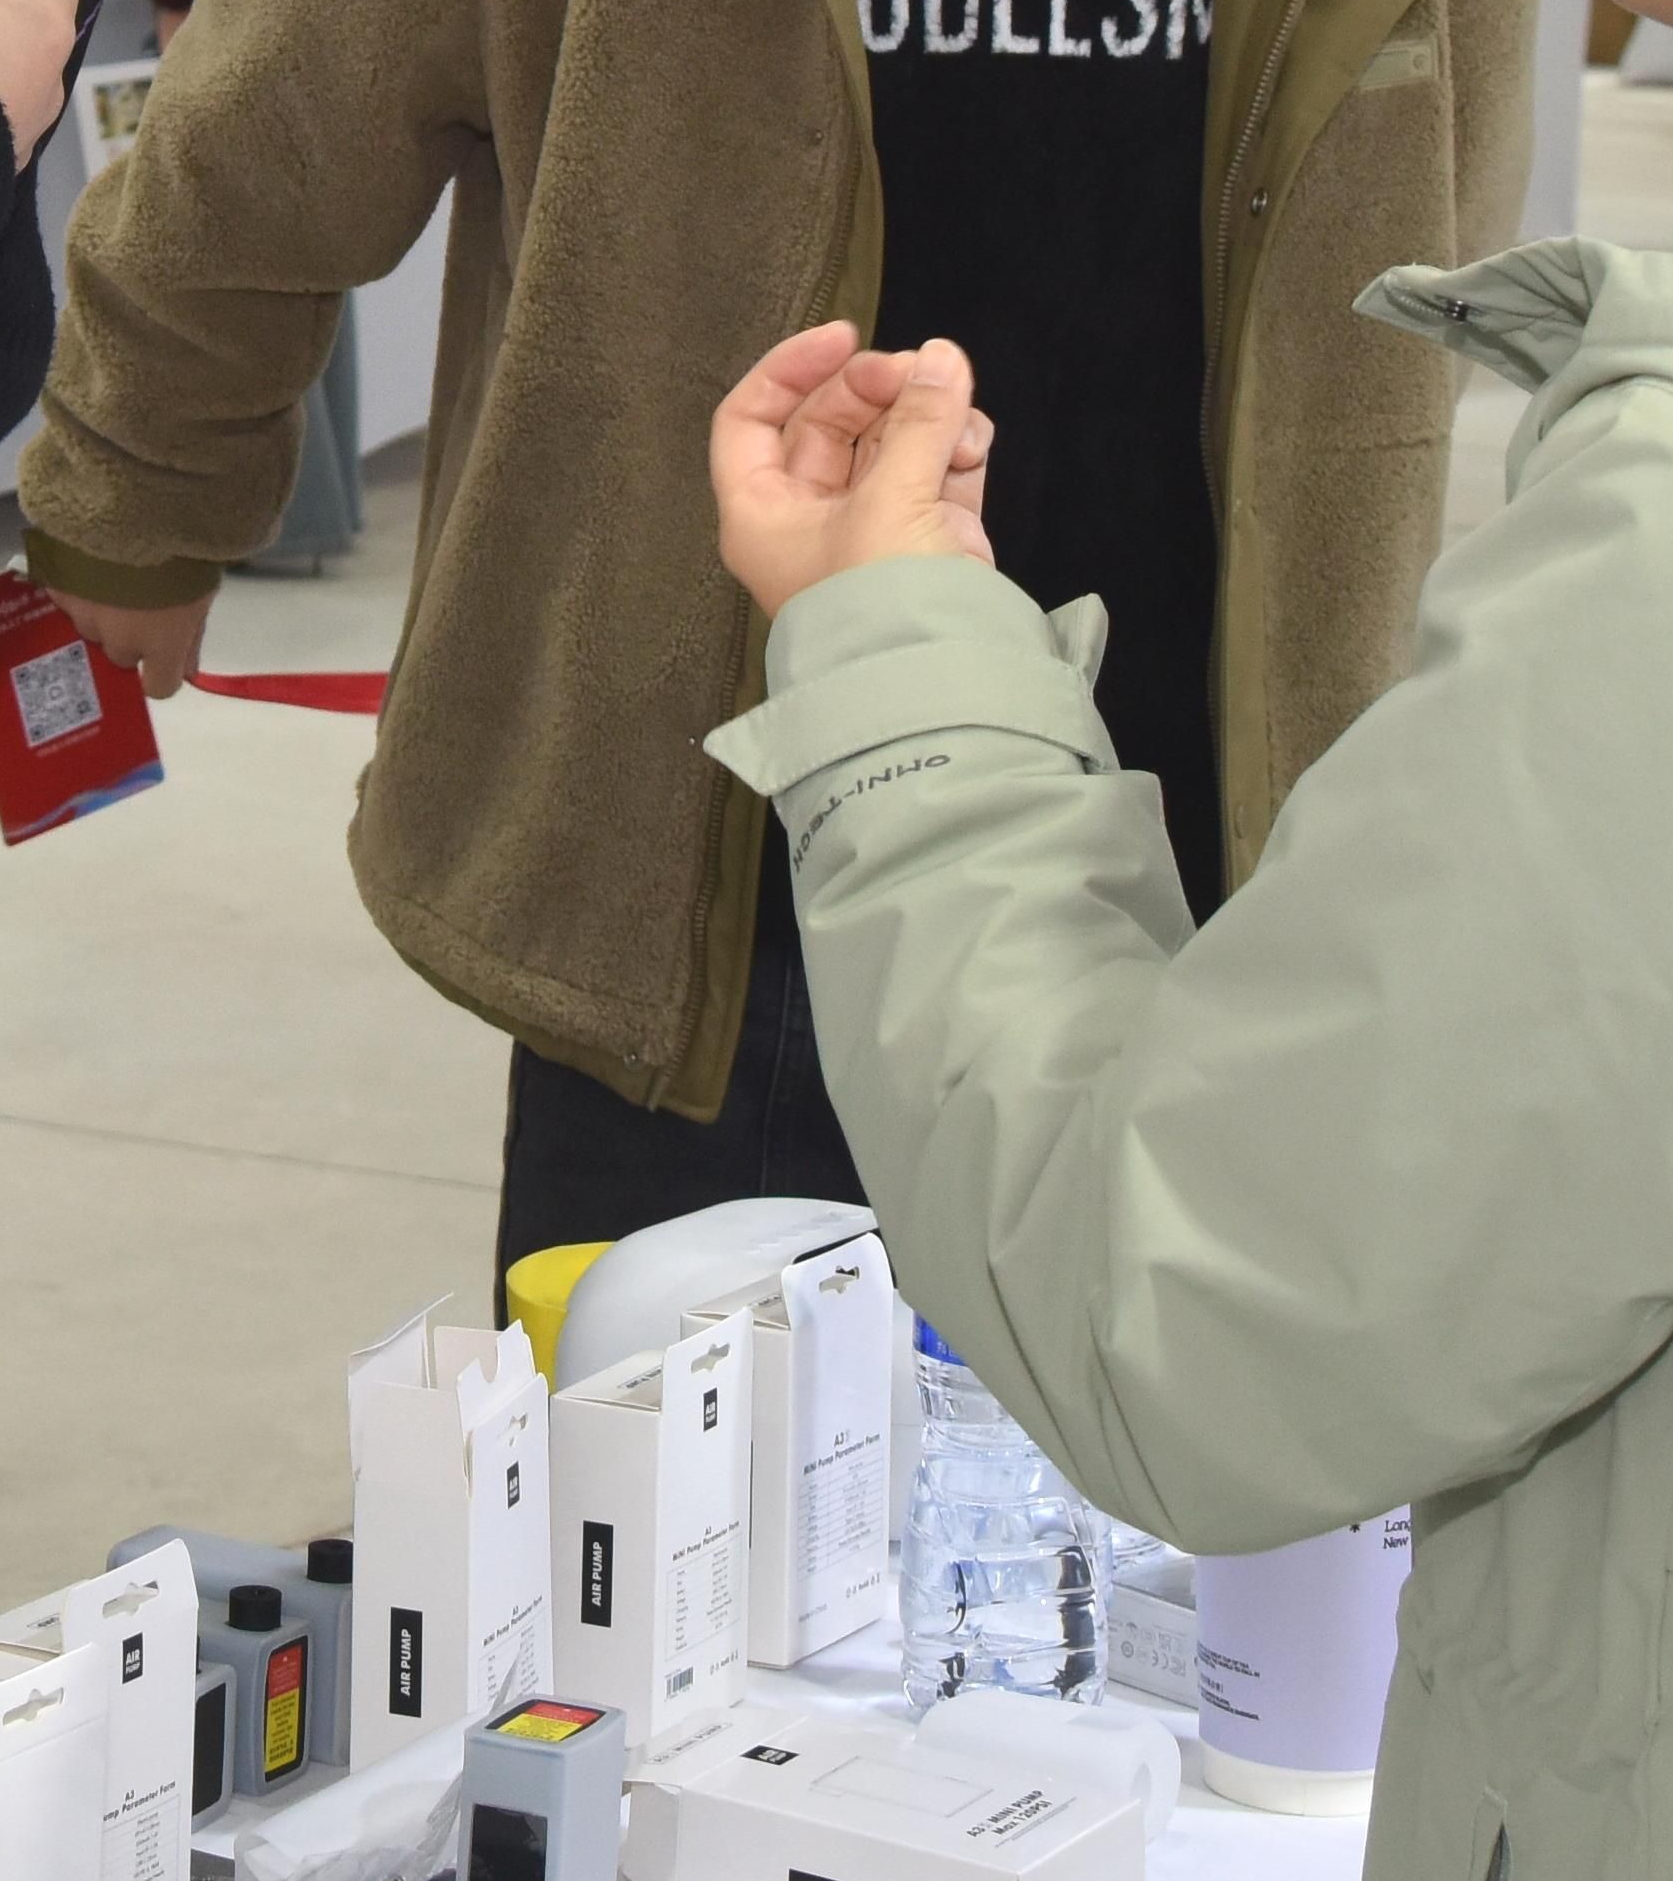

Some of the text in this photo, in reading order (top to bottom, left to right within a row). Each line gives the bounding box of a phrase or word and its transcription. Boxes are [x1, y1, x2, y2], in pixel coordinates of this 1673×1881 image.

[793, 754, 952, 873] OMNI-TECH
[1384, 1519, 1410, 1533] Lon
[1383, 1536, 1409, 1550] New
[591, 1541, 603, 1608] AIR PUMP
[125, 1648, 141, 1666] AIR
[400, 1628, 412, 1697] AIR PUMP
[121, 1790, 159, 1813] Parameter
[987, 1806, 1018, 1824] MINI
[1011, 1789, 1043, 1808] PUMP
[991, 1820, 1019, 1835] Max
